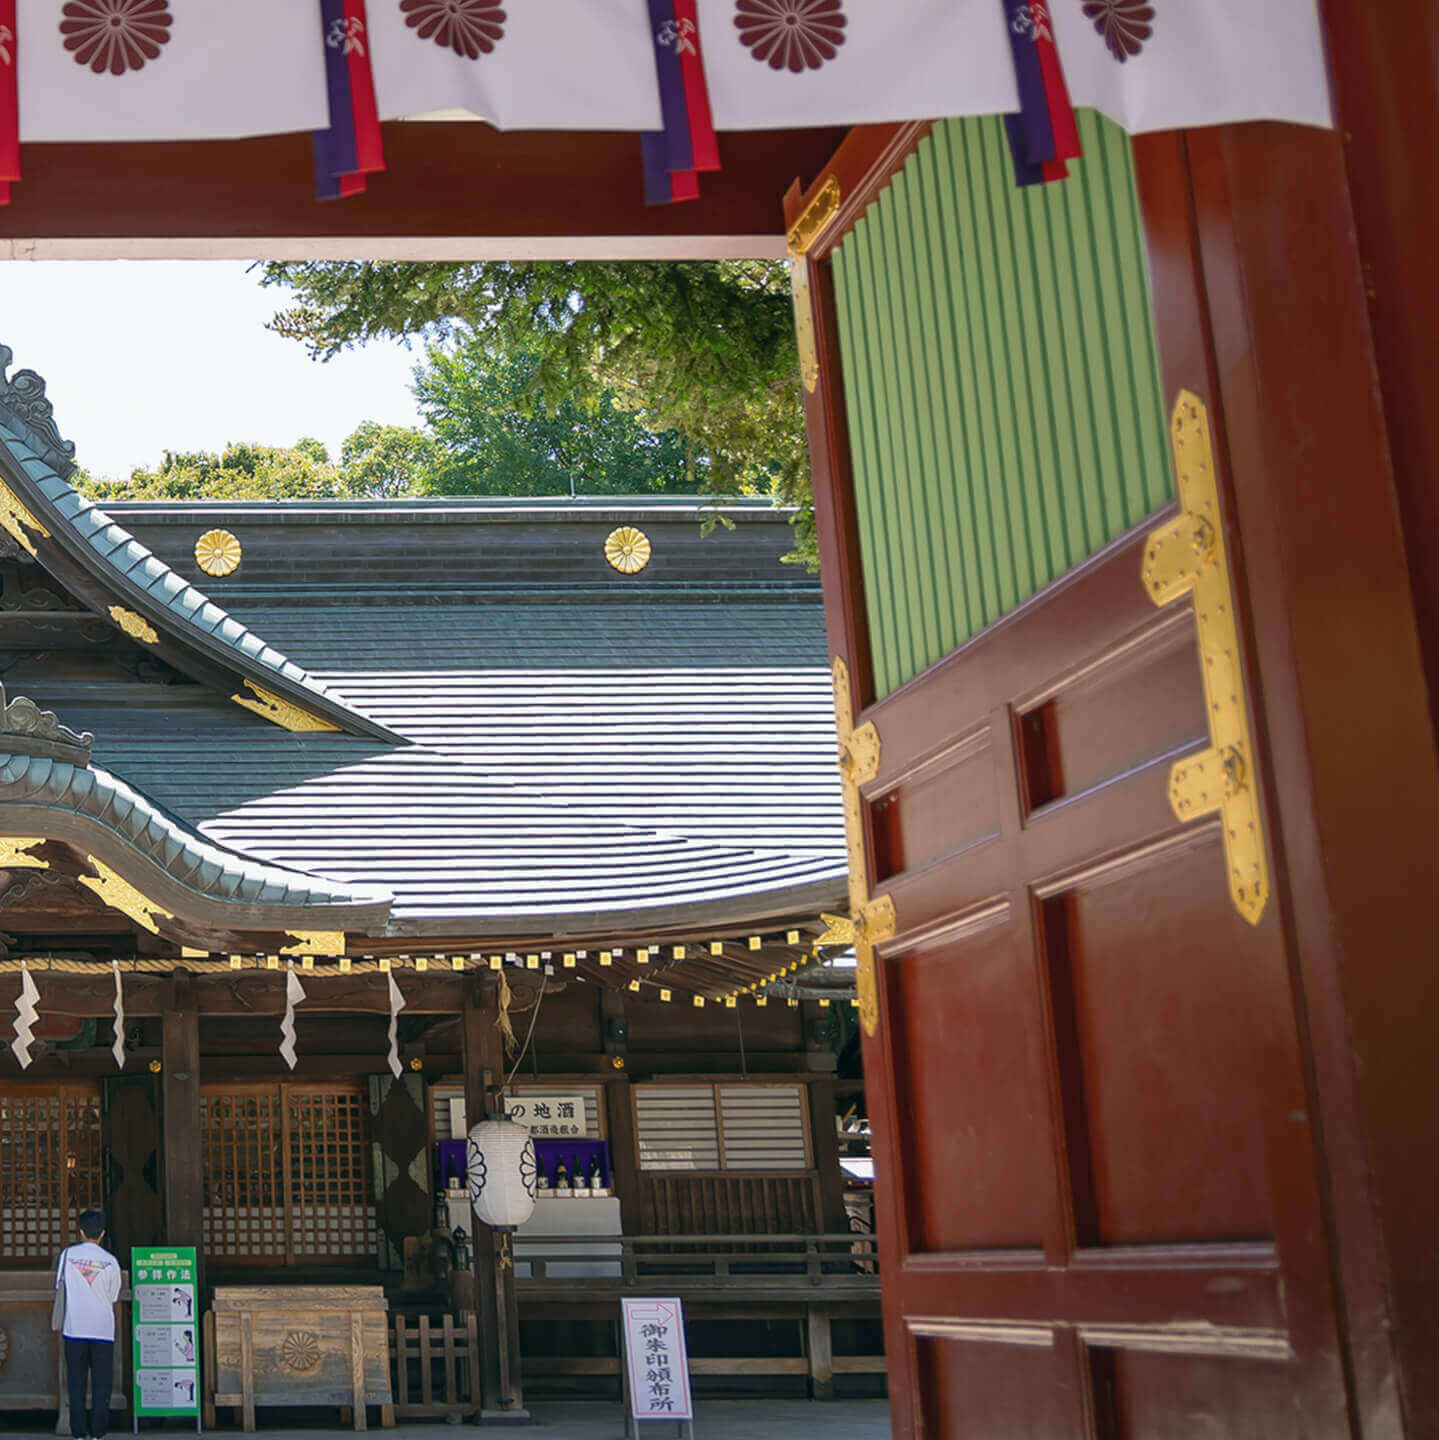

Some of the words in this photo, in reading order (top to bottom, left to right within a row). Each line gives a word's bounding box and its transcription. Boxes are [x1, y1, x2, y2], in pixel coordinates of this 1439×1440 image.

[639, 1324, 674, 1412] 御朱印頒布所
